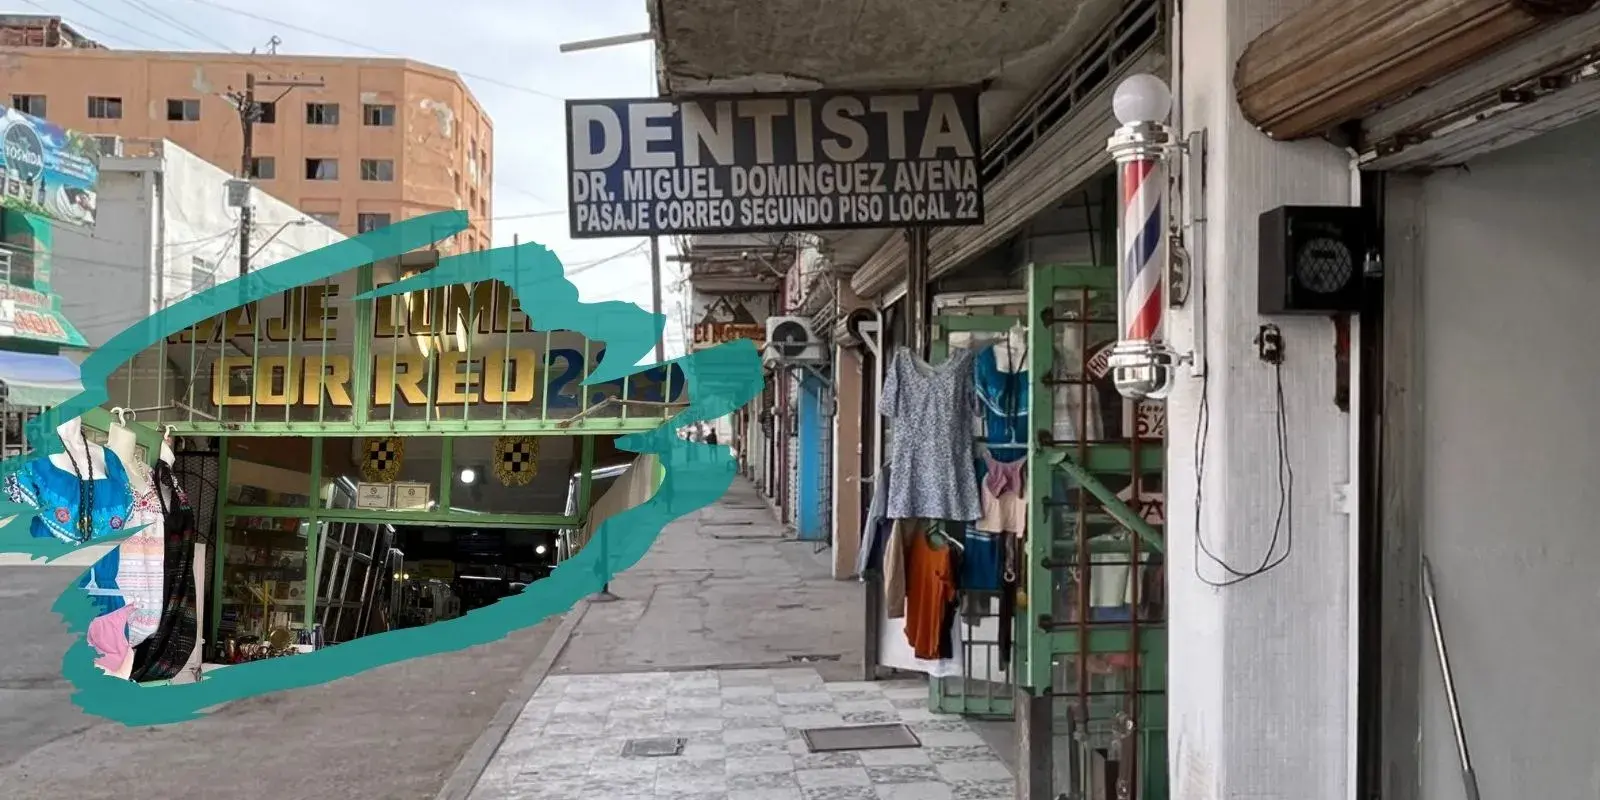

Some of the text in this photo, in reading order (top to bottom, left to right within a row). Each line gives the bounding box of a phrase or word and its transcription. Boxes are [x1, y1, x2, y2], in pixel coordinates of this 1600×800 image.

[571, 93, 975, 170] DENTISTA
[572, 160, 978, 202] DR. MIGUEL DOMINGUEZ AVENA
[577, 191, 978, 232] PASAJE CORREO SEGUNDO PISO LOCAL 22
[210, 349, 535, 407] CORREO
